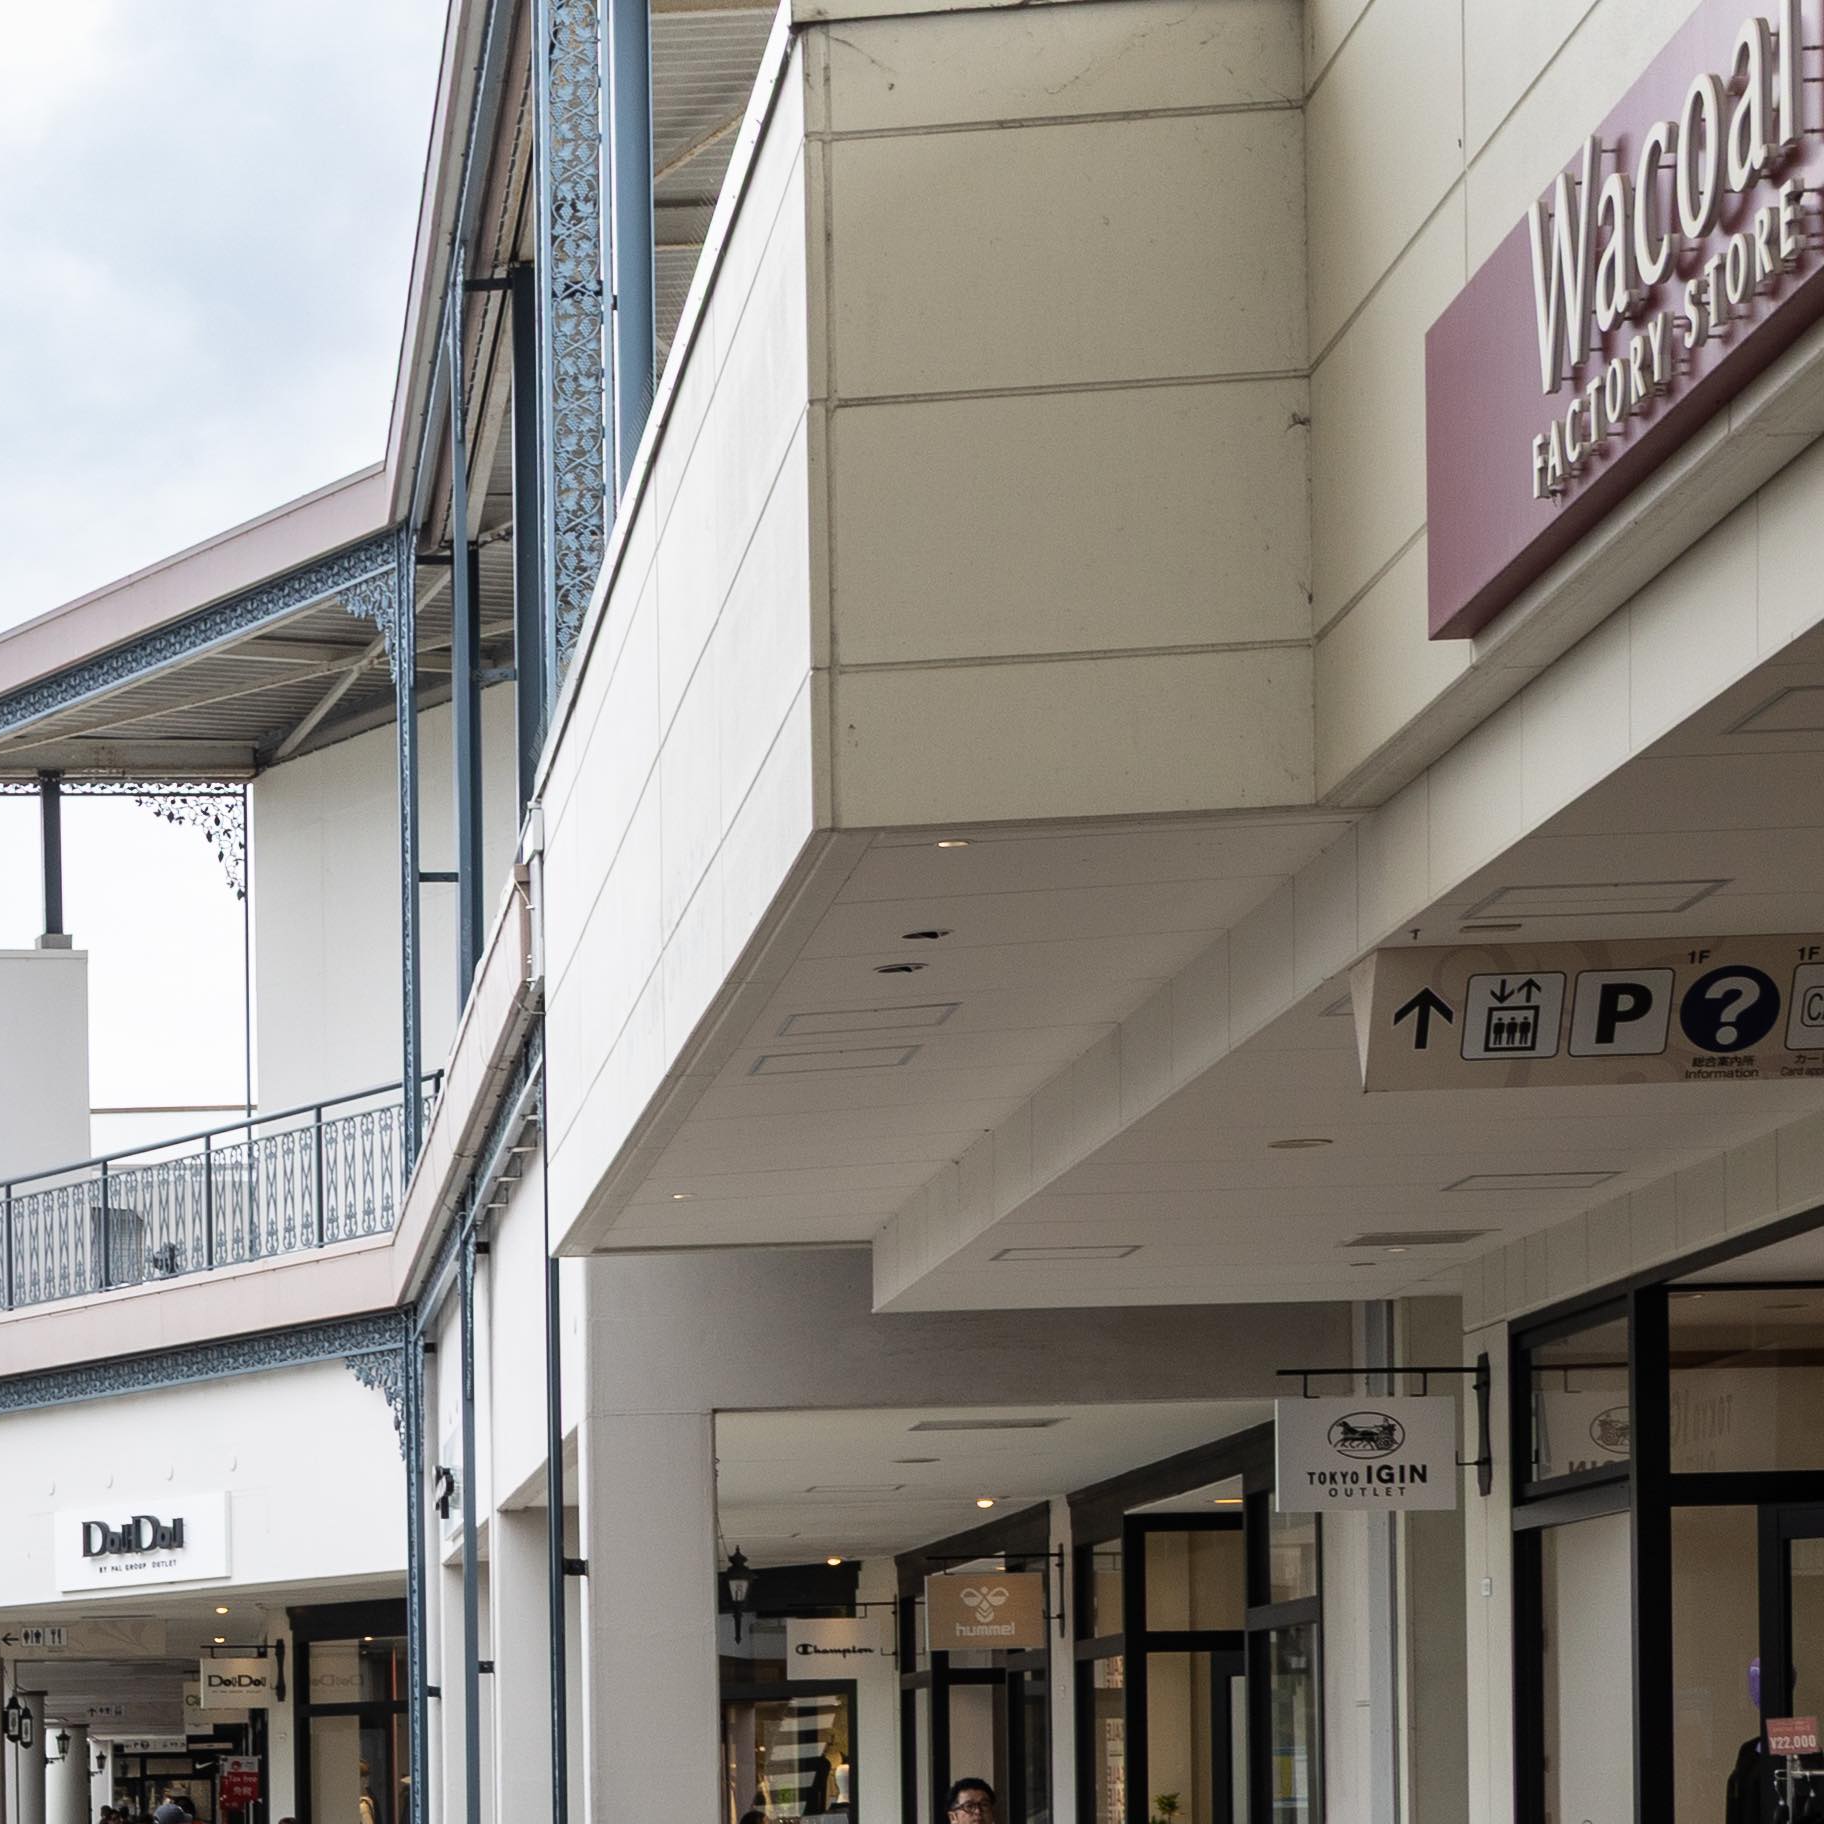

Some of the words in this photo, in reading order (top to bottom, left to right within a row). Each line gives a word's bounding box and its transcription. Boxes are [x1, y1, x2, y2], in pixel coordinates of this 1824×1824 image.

[1529, 0, 1802, 395] Wacoal
[1532, 311, 1673, 499] FACTORY
[1684, 177, 1805, 349] STORE
[1688, 950, 1711, 964] 1F
[1798, 946, 1821, 960] 1F
[1594, 982, 1653, 1044] P
[1685, 1068, 1759, 1079] Information
[1307, 1471, 1359, 1485] TOKYO
[1366, 1464, 1427, 1484] IGIN
[1328, 1486, 1407, 1497] OUTLET
[955, 1622, 1016, 1637] hummel
[795, 1642, 875, 1658] Champion
[1770, 1735, 1816, 1750] ¥22,000
